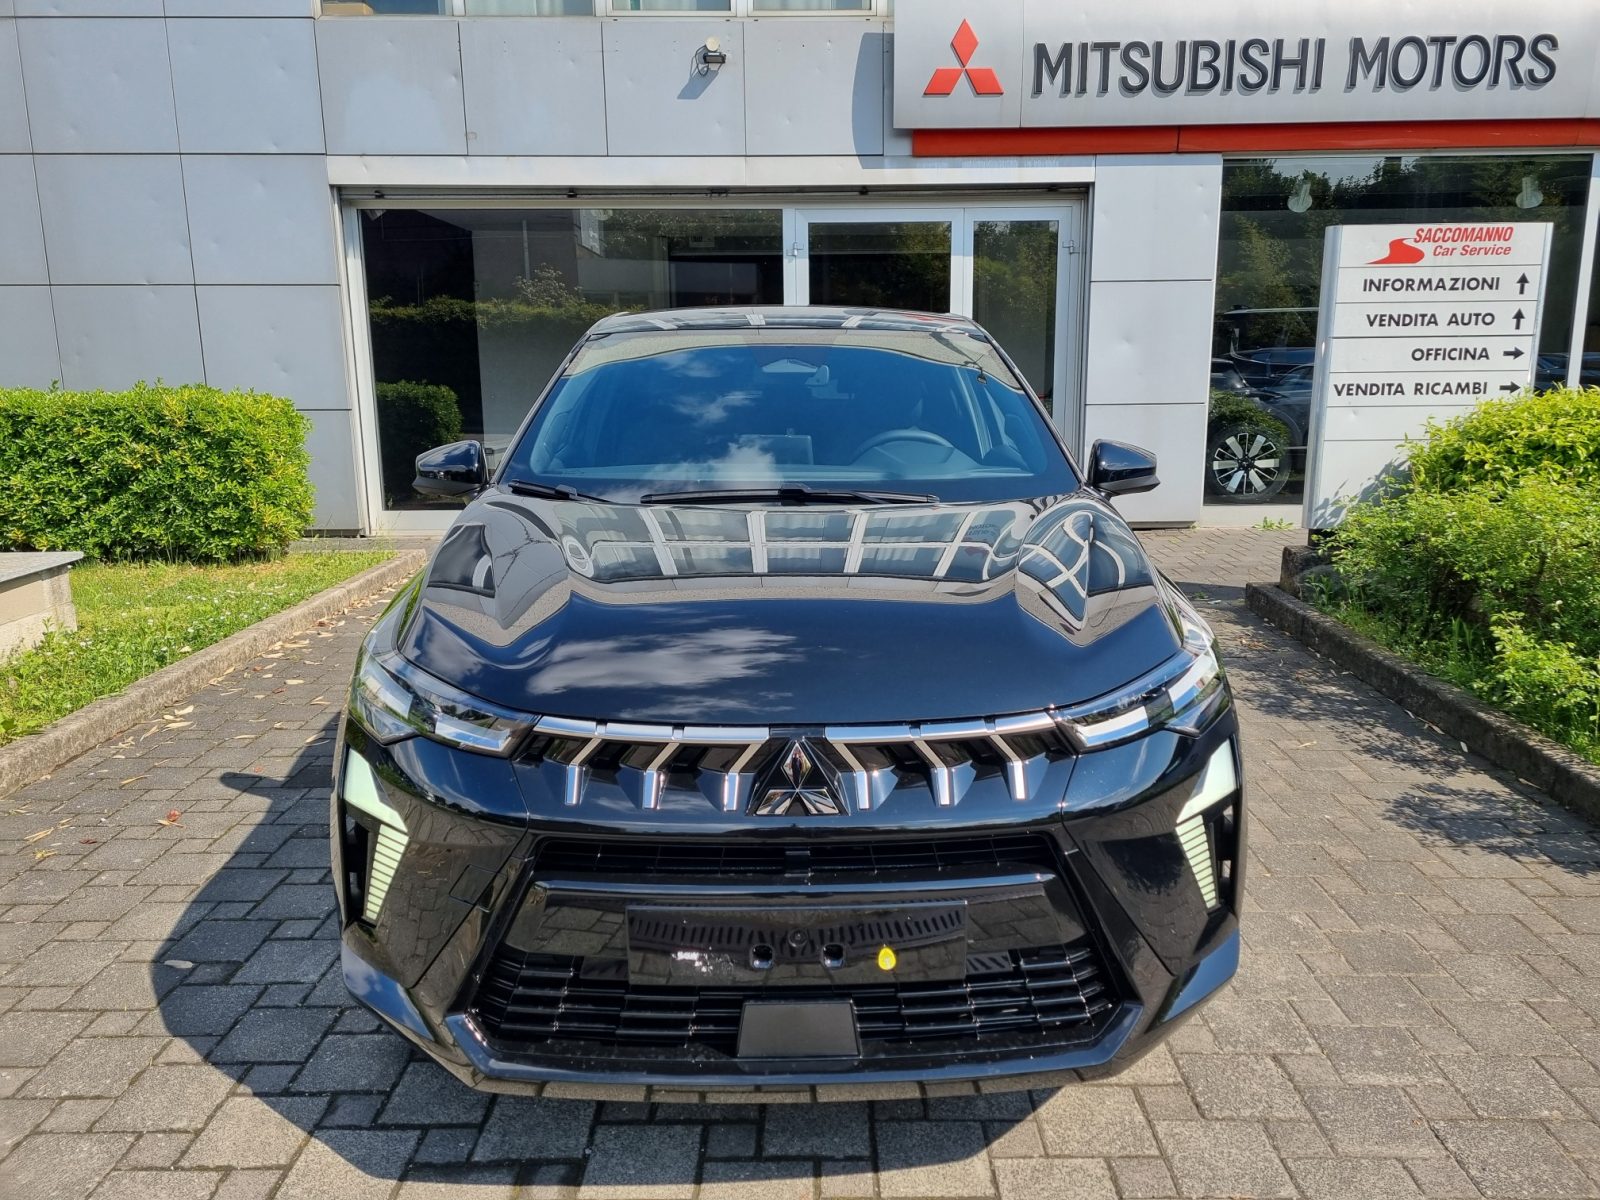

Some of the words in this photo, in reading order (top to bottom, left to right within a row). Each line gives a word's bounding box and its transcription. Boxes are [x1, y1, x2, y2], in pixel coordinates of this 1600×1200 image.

[1032, 38, 1326, 95] MITSUBISHI
[1347, 34, 1559, 89] MOTORS
[1413, 226, 1515, 243] SACCOMANNO
[1432, 244, 1457, 257] Car
[1459, 244, 1512, 256] Service
[1362, 276, 1501, 292] INFORMAZIONI
[1365, 313, 1439, 328] VENDITA
[1446, 312, 1496, 326] AUTO
[1410, 347, 1490, 362] OFFICINA
[1333, 382, 1405, 397] VENDITA
[1413, 381, 1488, 396] RICAMBI
